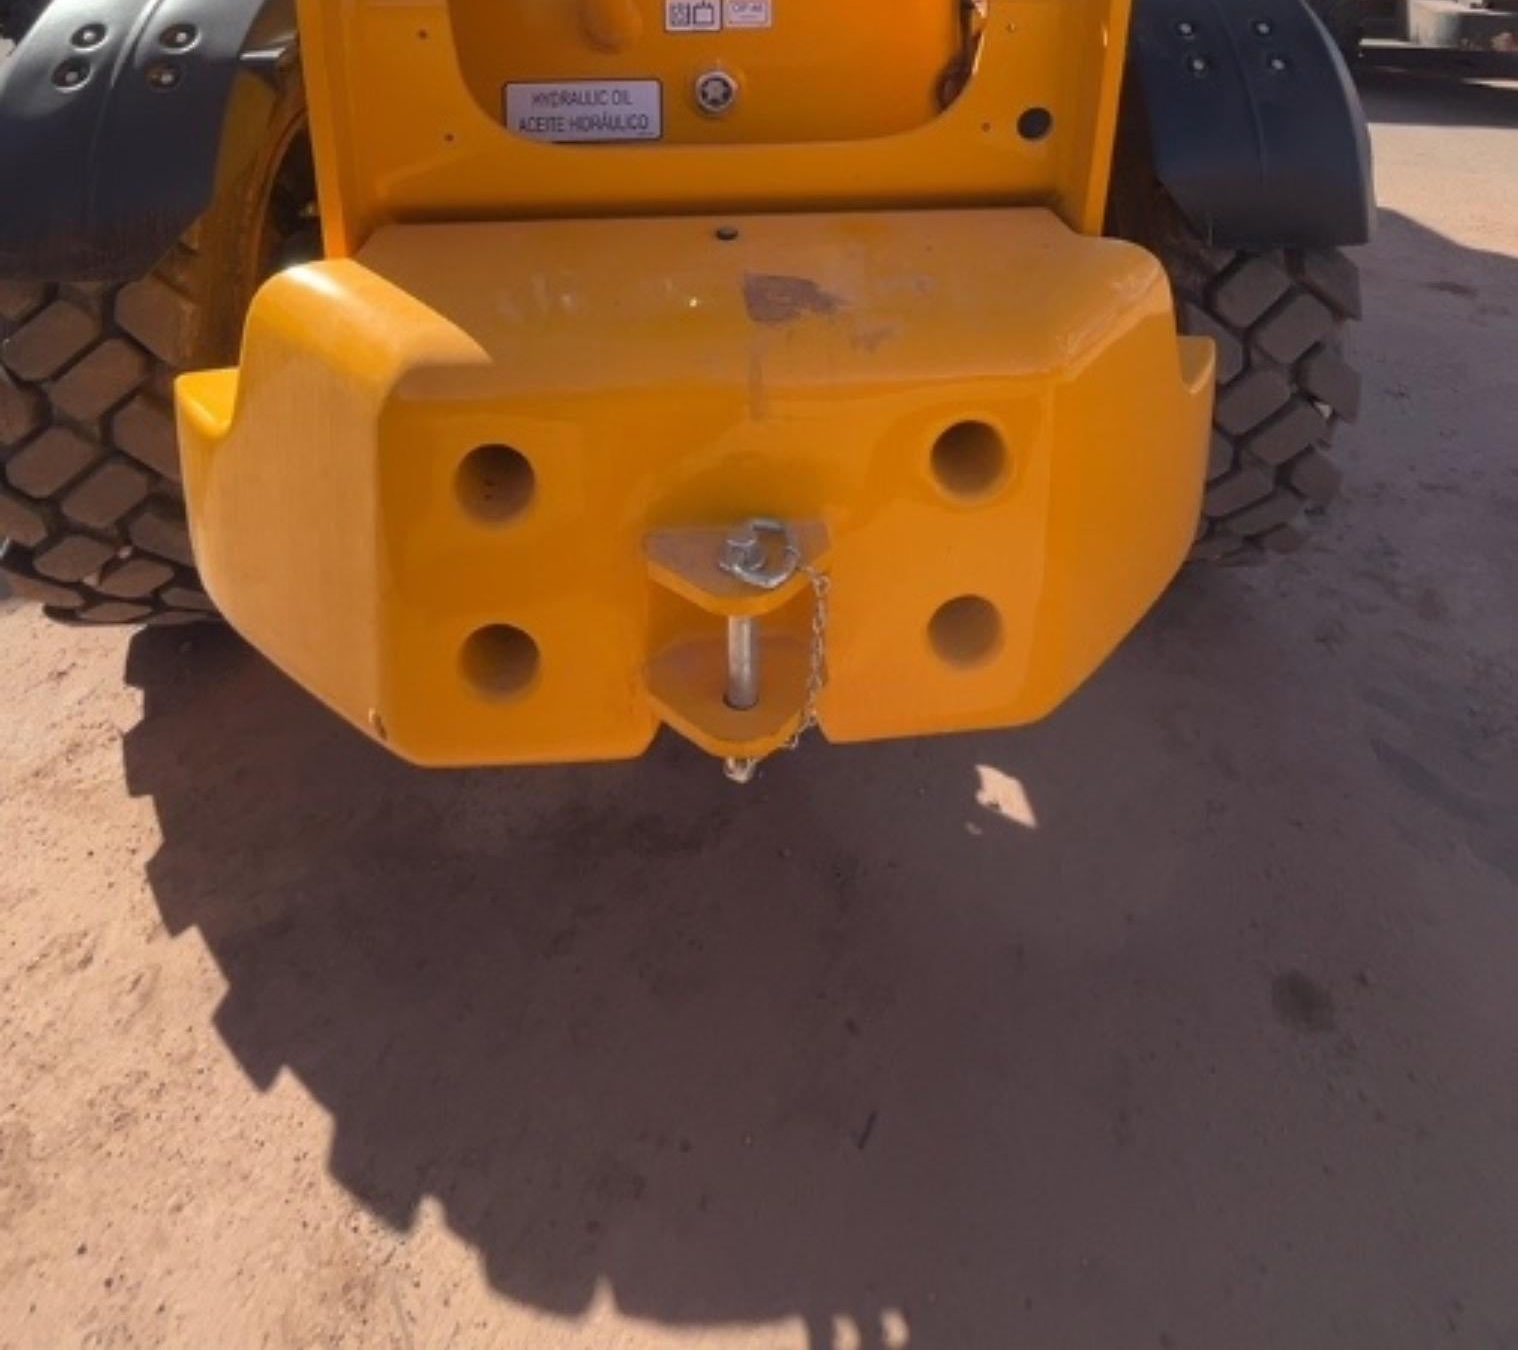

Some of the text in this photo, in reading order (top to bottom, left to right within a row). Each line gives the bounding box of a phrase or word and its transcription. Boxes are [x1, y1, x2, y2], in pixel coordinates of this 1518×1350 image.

[531, 89, 634, 107] HYDRAULIC OIL
[518, 116, 564, 132] ACEITE
